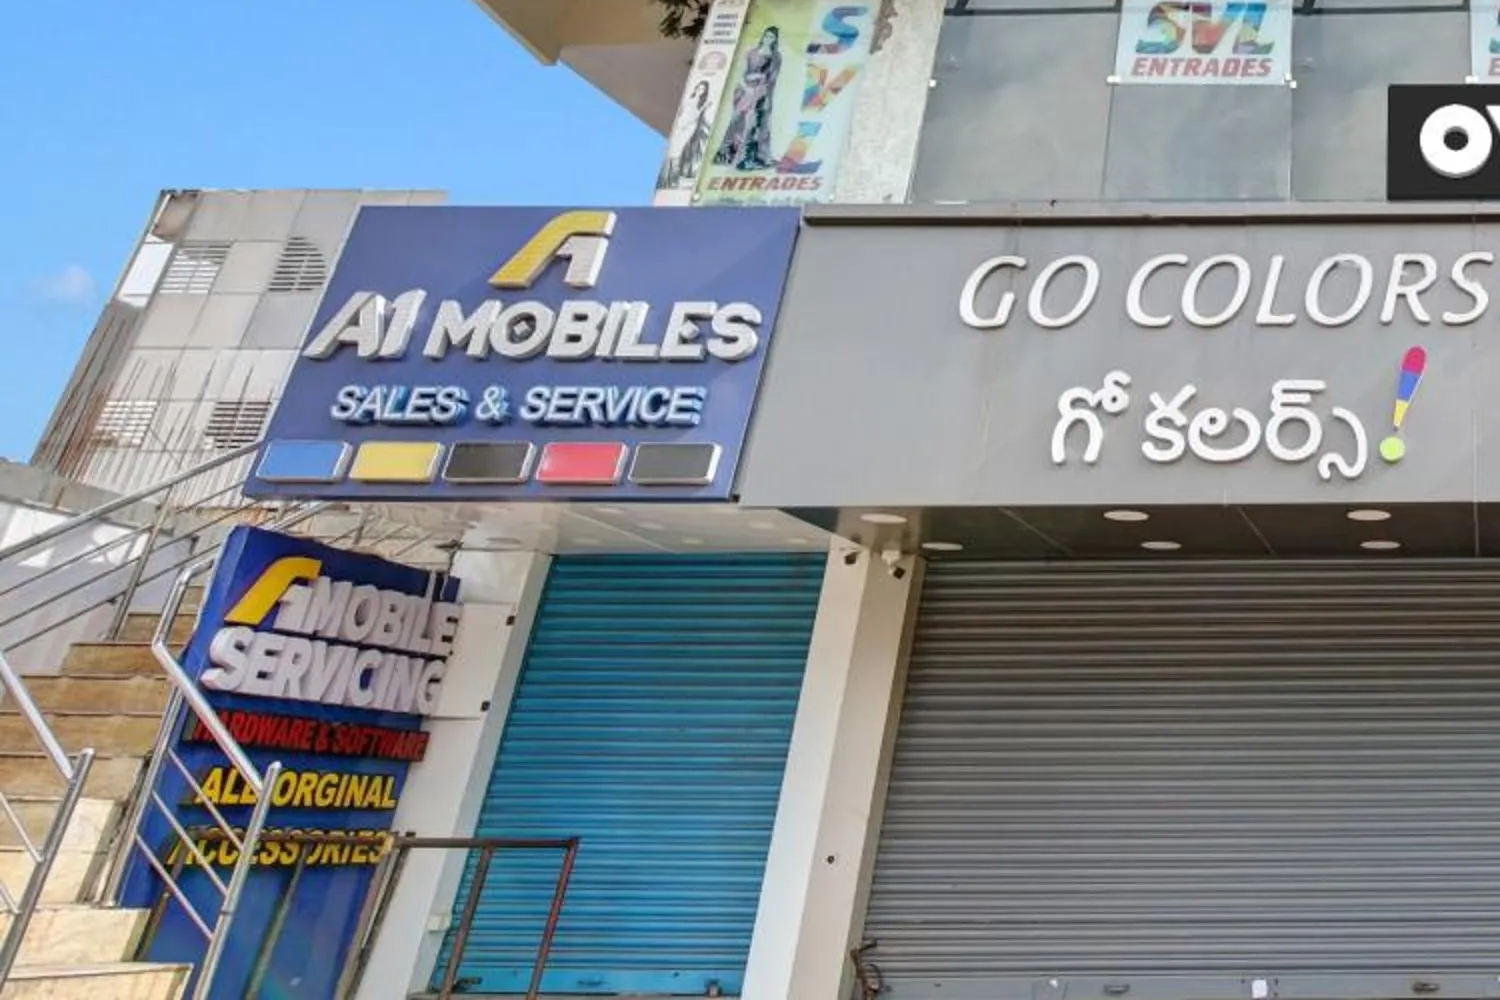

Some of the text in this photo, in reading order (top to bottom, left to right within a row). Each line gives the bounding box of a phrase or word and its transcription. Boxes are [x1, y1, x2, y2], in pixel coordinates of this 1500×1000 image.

[1135, 0, 1275, 55] SVL
[1131, 56, 1271, 79] ENTRADES
[706, 176, 823, 191] ENTRADES
[959, 254, 1100, 329] GO
[423, 299, 763, 361] MOBILES
[330, 384, 707, 427] SALES & SERVICE
[1051, 370, 1132, 465] గో
[304, 576, 462, 656] MOBILE
[200, 626, 447, 716] SERVICING
[315, 722, 328, 750] &
[331, 724, 429, 761] SOFTWARE
[272, 769, 397, 808] ORGINAL
